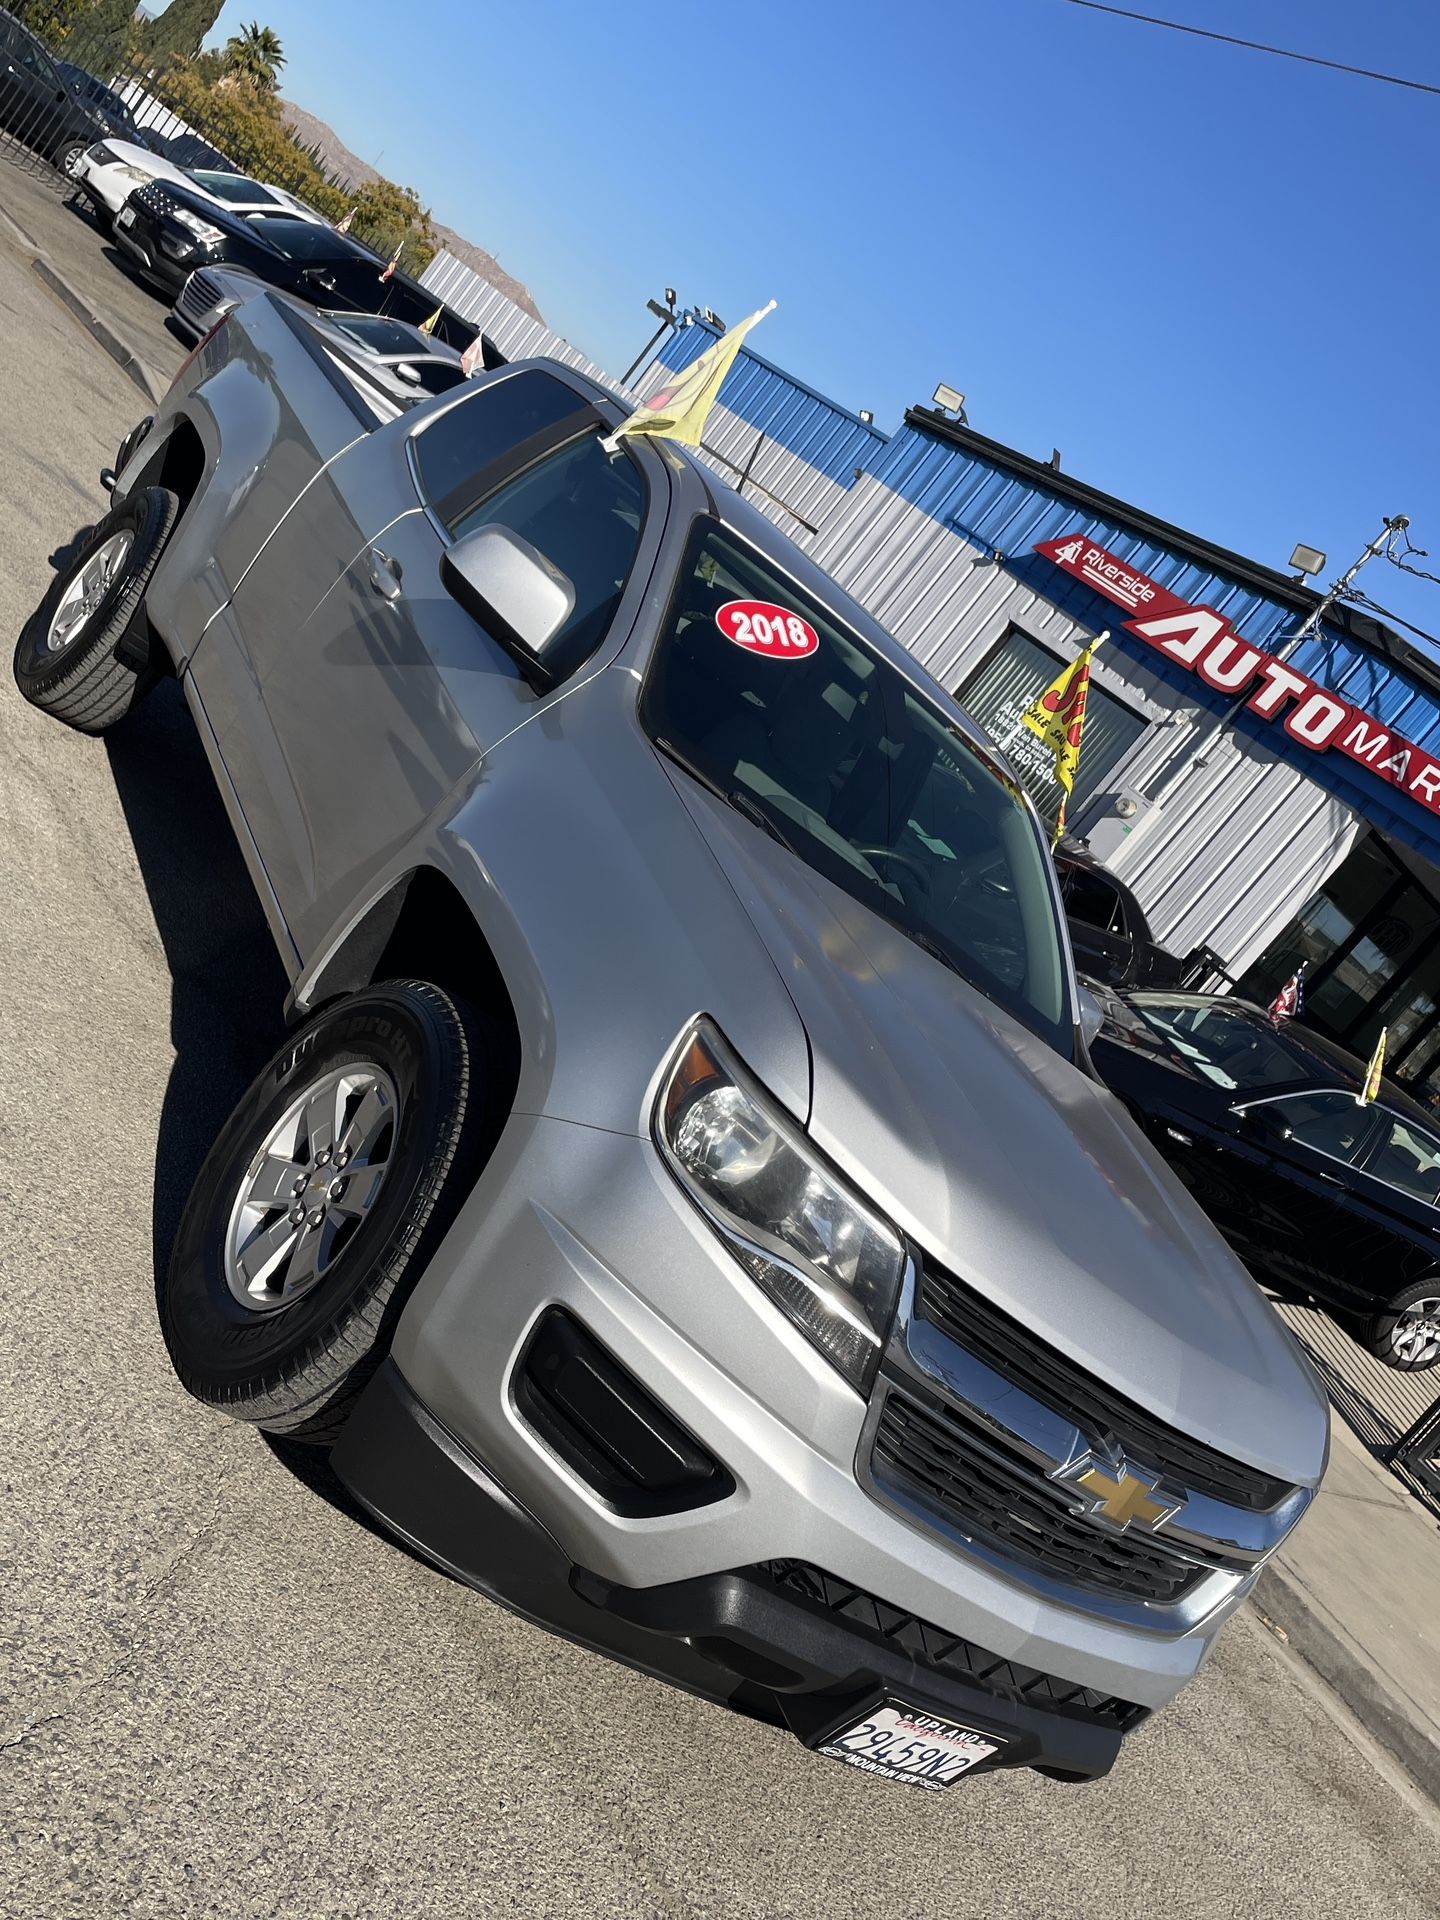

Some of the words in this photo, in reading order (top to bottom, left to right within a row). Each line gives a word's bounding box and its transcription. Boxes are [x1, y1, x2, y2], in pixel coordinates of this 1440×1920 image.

[1082, 548, 1156, 603] Riverside
[731, 611, 809, 648] 2018
[1027, 709, 1051, 728] SALE
[1135, 609, 1346, 746] AUTO
[1342, 721, 1440, 809] MAR
[1017, 728, 1032, 743] Van
[1030, 738, 1053, 758] Buren
[914, 1715, 980, 1743] UPLAND
[840, 1723, 971, 1783] 29459N2
[848, 1755, 897, 1779] MOUNTAIN
[895, 1771, 922, 1785] VIEW
